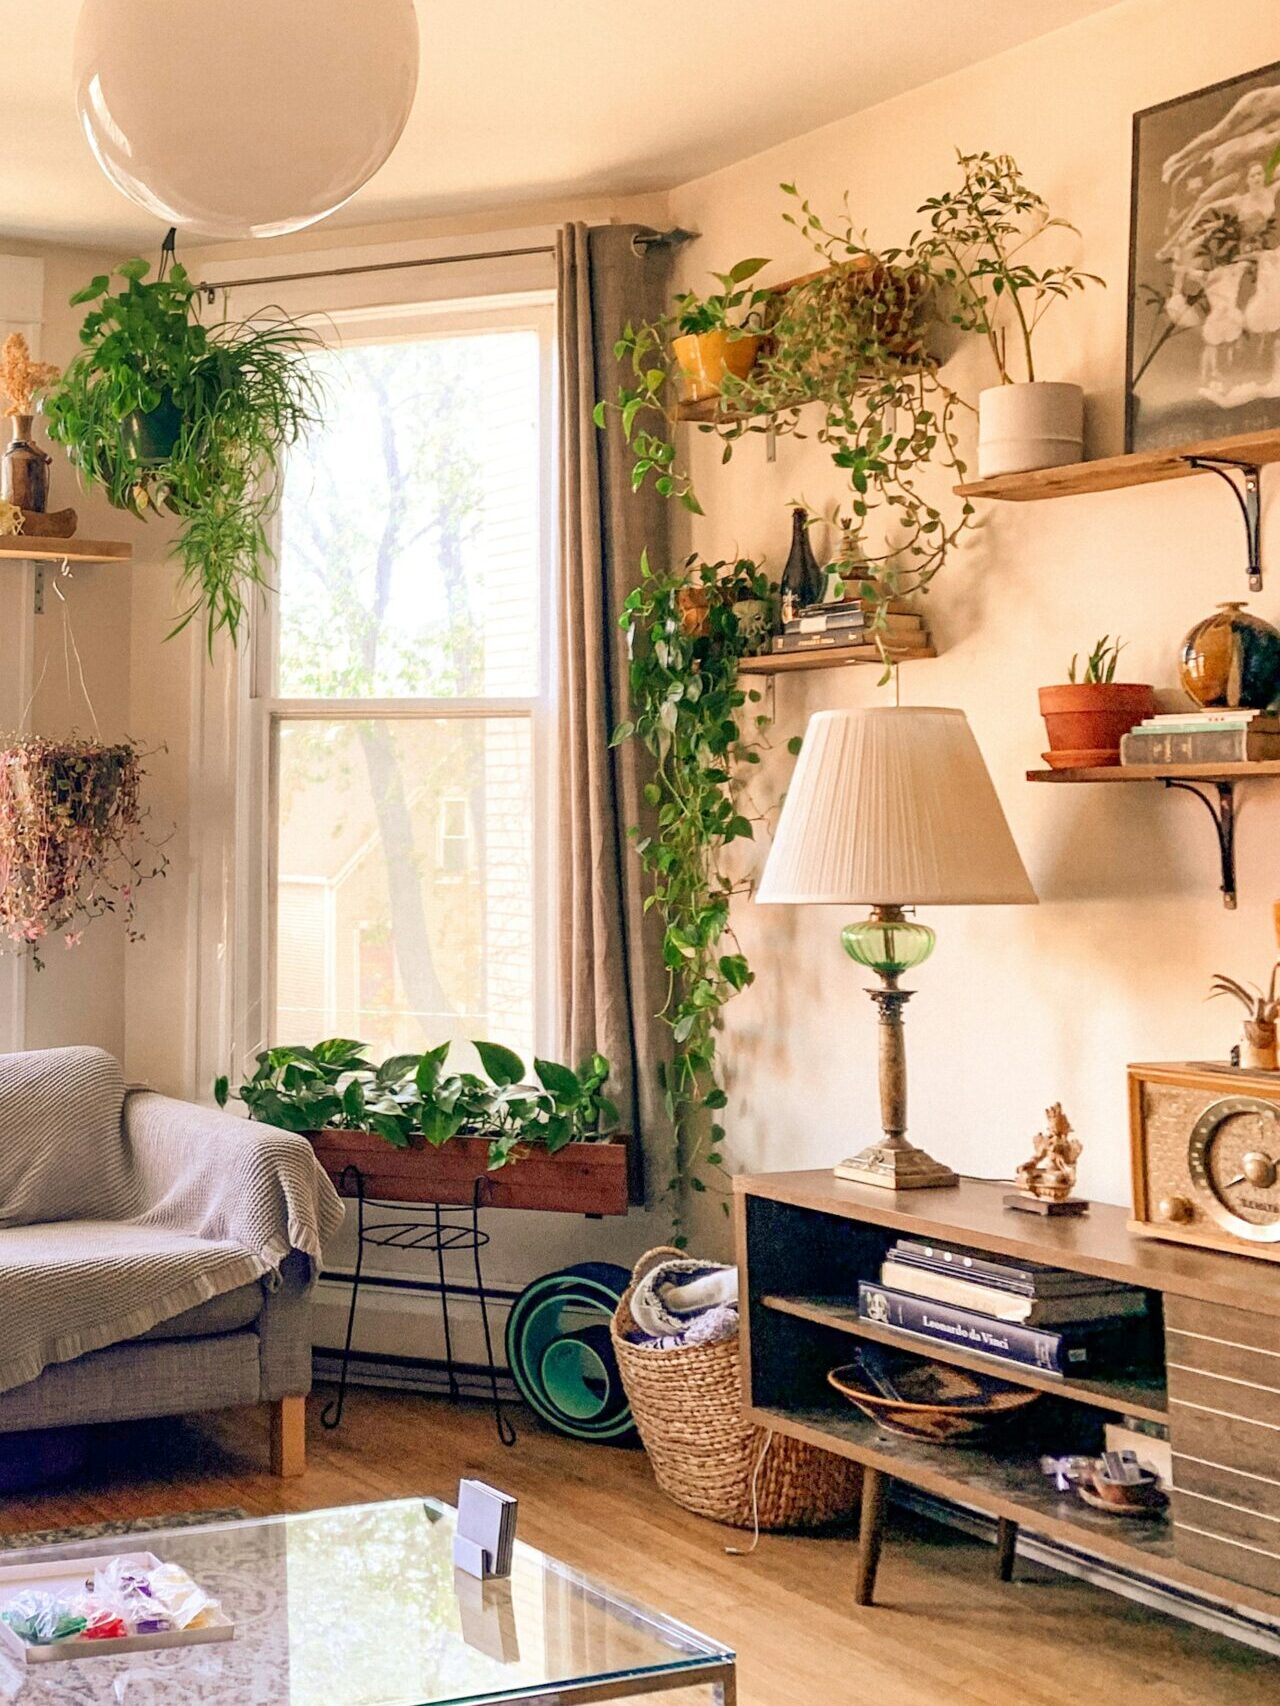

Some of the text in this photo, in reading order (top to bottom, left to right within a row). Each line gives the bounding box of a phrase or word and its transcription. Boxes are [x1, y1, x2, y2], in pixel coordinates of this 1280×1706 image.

[922, 1315, 1009, 1350] Leonardo da Vinci
